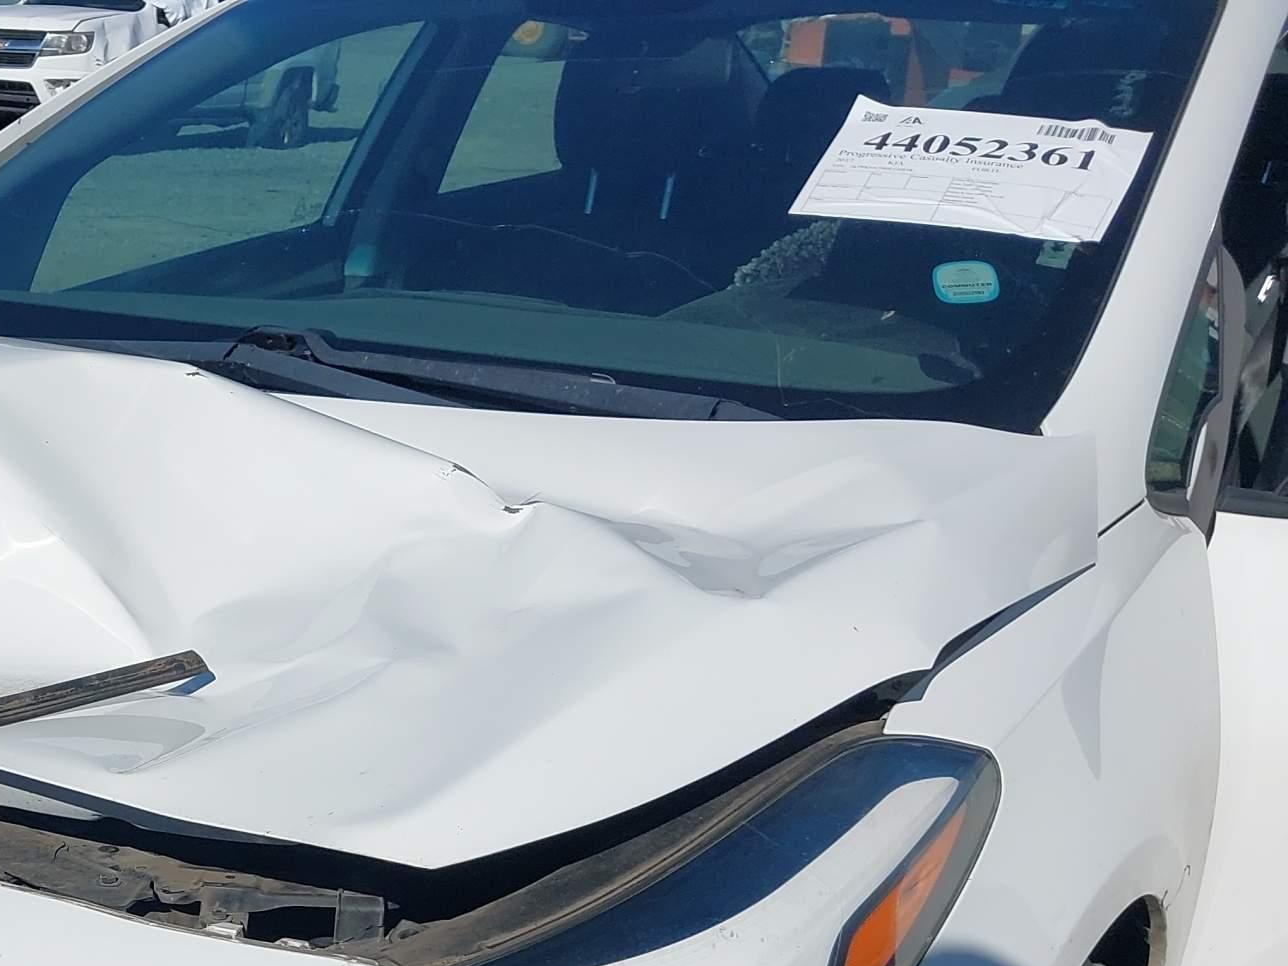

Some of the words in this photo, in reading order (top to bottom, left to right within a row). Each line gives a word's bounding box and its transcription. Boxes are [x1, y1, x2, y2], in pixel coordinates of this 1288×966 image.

[838, 149, 907, 159] Progressive
[910, 155, 960, 164] Casualty
[965, 157, 1025, 169] Insurance
[863, 132, 1096, 171] 44052361
